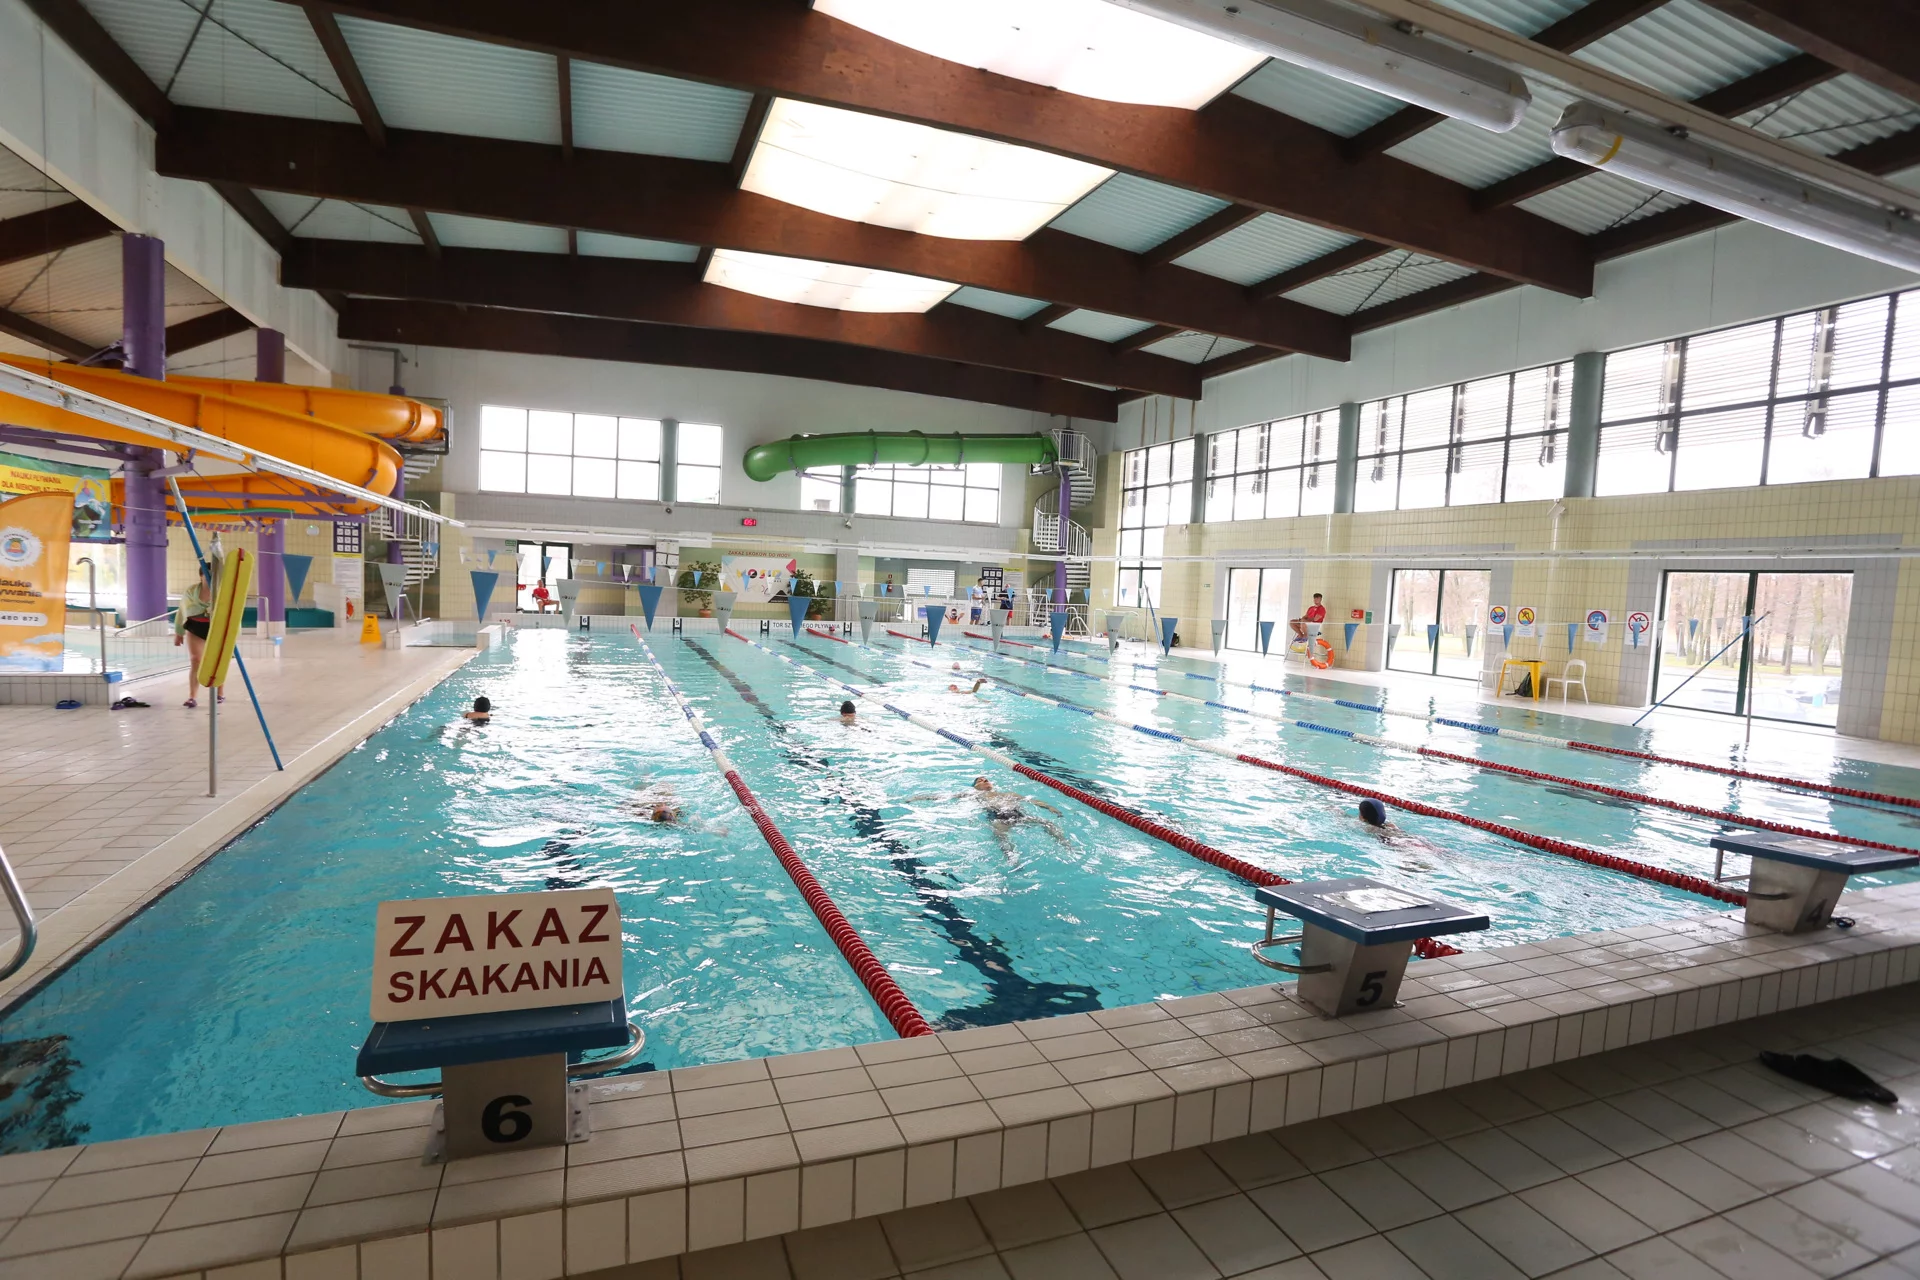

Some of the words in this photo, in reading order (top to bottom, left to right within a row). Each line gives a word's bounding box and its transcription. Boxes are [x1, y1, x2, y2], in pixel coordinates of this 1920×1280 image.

[0, 579, 32, 588] auka
[389, 904, 610, 957] ZAKAZ
[1805, 898, 1828, 926] 4
[387, 956, 611, 1004] SKAKANIA
[1356, 970, 1388, 1007] 5
[481, 1095, 533, 1144] 6
